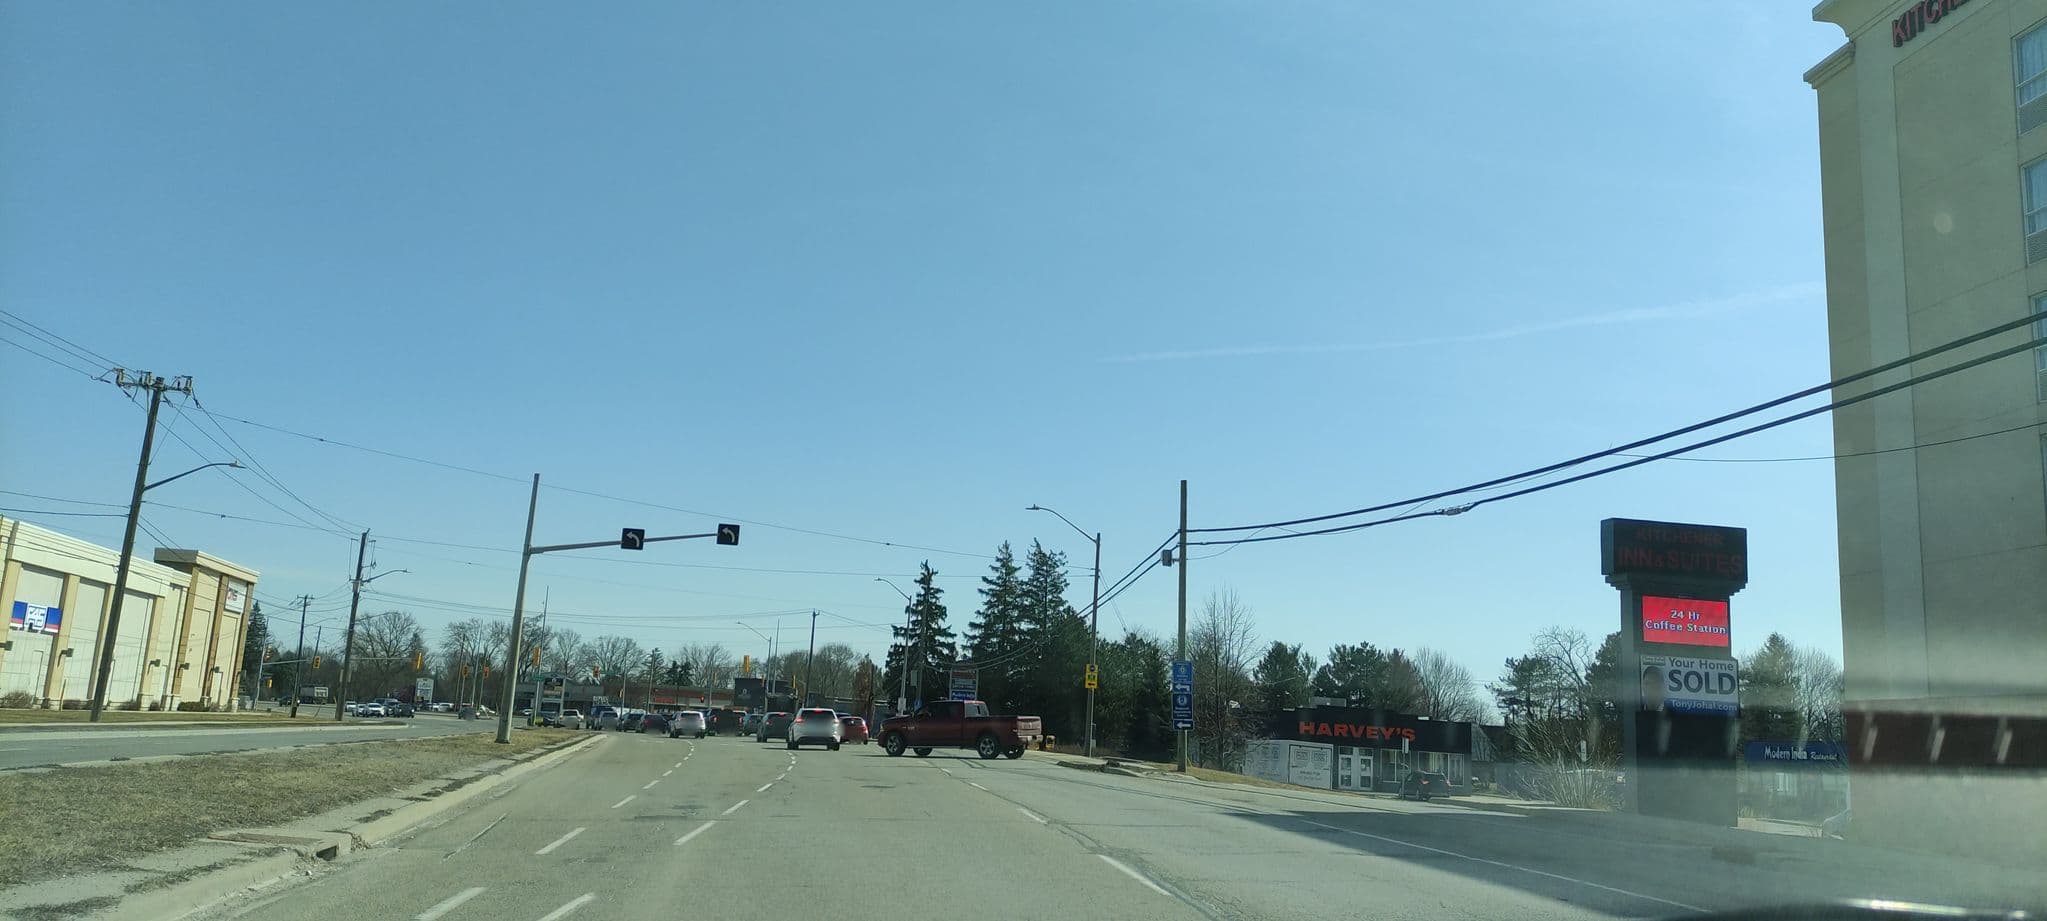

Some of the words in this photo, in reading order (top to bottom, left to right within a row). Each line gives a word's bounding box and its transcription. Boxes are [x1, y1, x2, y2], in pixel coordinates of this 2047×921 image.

[1618, 545, 1654, 567] INN
[1667, 549, 1744, 576] SUITES
[1671, 609, 1684, 619] 24
[1688, 611, 1700, 620] Hr
[1645, 620, 1683, 631] Coffee
[1687, 622, 1726, 634] Station
[1669, 657, 1695, 668] Your
[1699, 660, 1734, 671] Home
[1668, 669, 1736, 695] SOLD
[1672, 699, 1738, 712] TonyJohal.com
[1299, 721, 1416, 742] HARVEY'S
[1764, 745, 1791, 760] Modern
[1791, 746, 1808, 760] India
